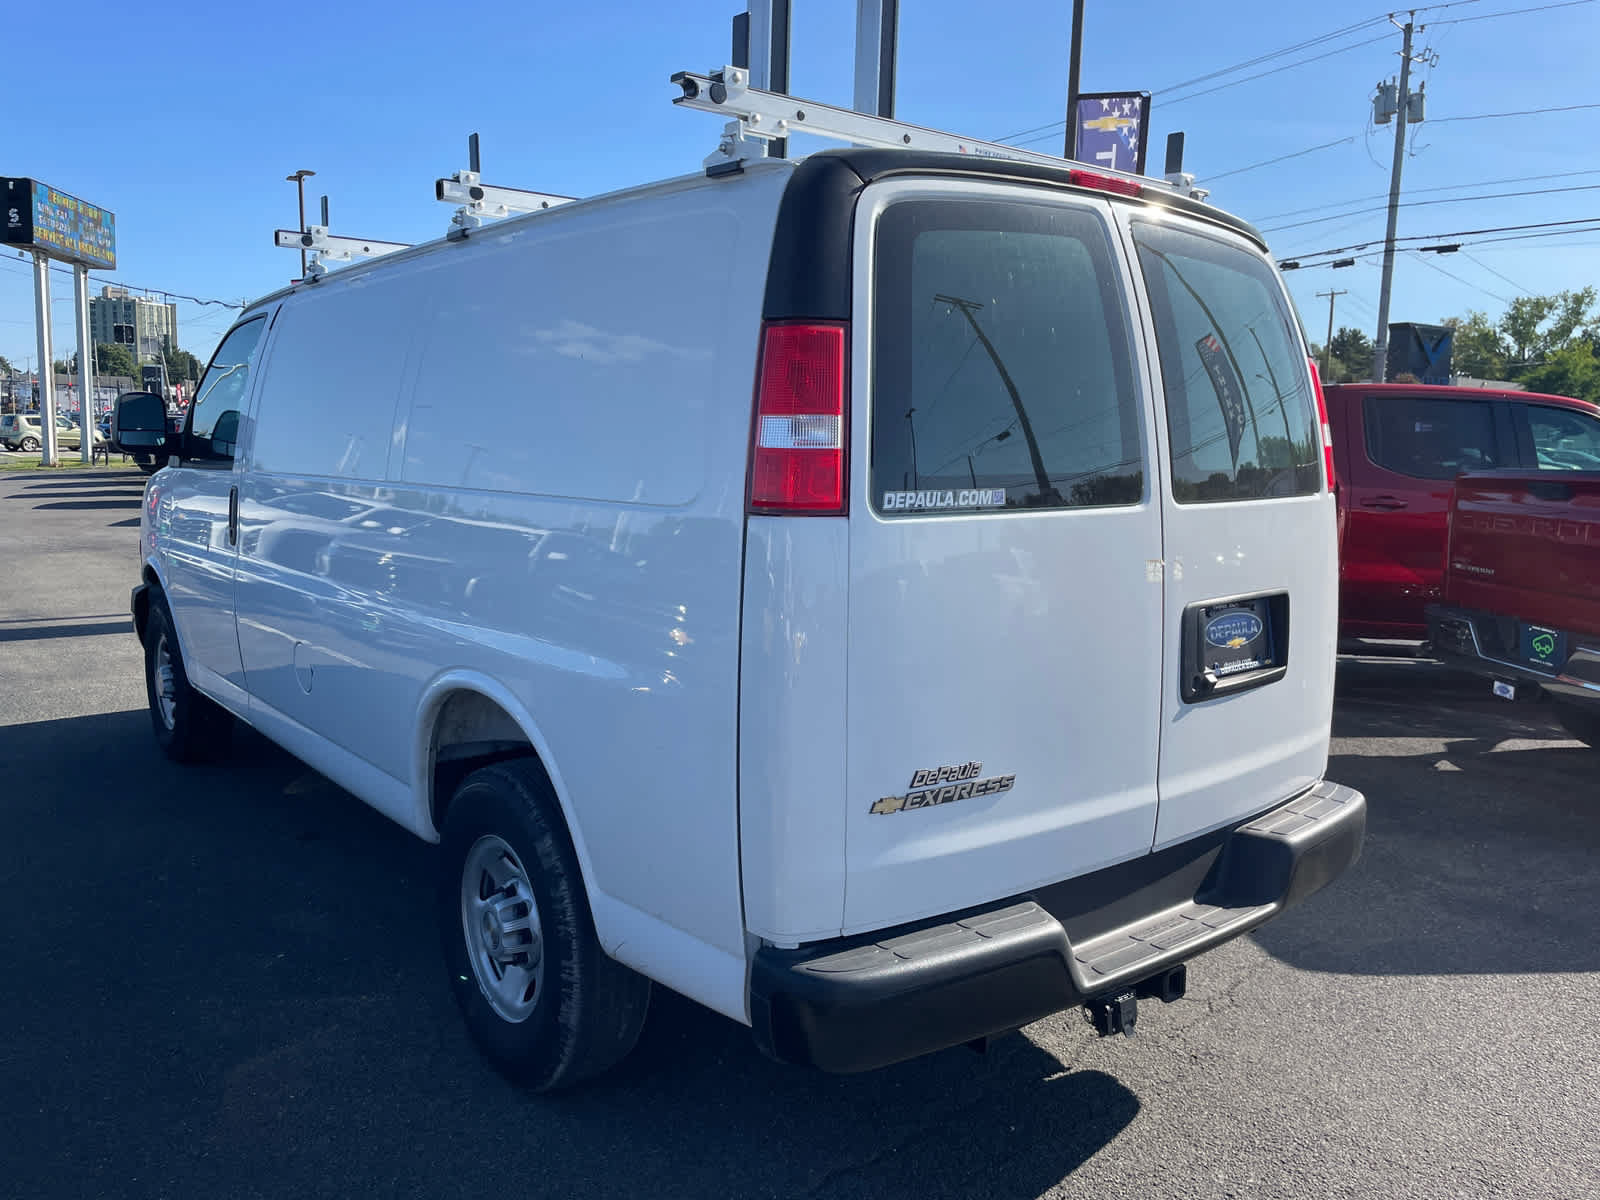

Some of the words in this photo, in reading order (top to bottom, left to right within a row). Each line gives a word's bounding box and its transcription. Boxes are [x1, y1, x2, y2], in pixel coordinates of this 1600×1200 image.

[882, 490, 993, 509] DEPAULA.COM
[1208, 619, 1259, 640] DEPAULA
[909, 760, 984, 789] DePaula
[900, 774, 1017, 812] EXPRESS
